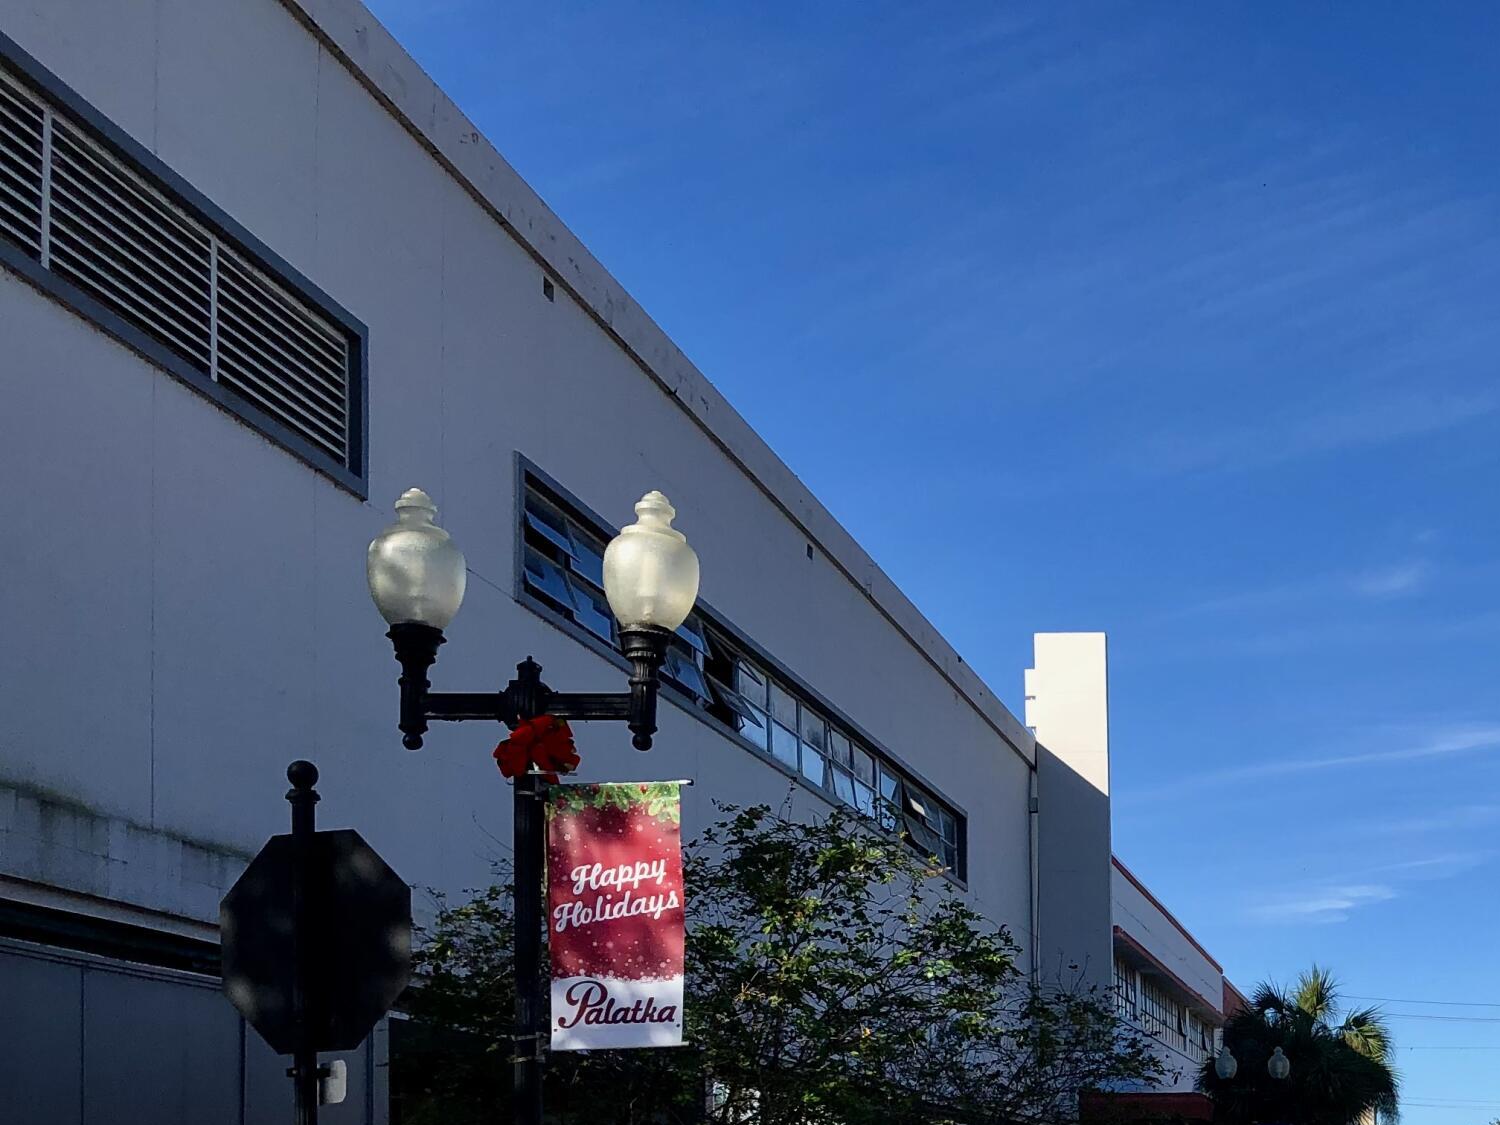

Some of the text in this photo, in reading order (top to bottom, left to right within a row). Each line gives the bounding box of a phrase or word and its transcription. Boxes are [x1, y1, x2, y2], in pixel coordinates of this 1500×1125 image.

[570, 858, 667, 896] Happy
[553, 890, 680, 933] Holidays
[558, 980, 678, 1029] Palatka
